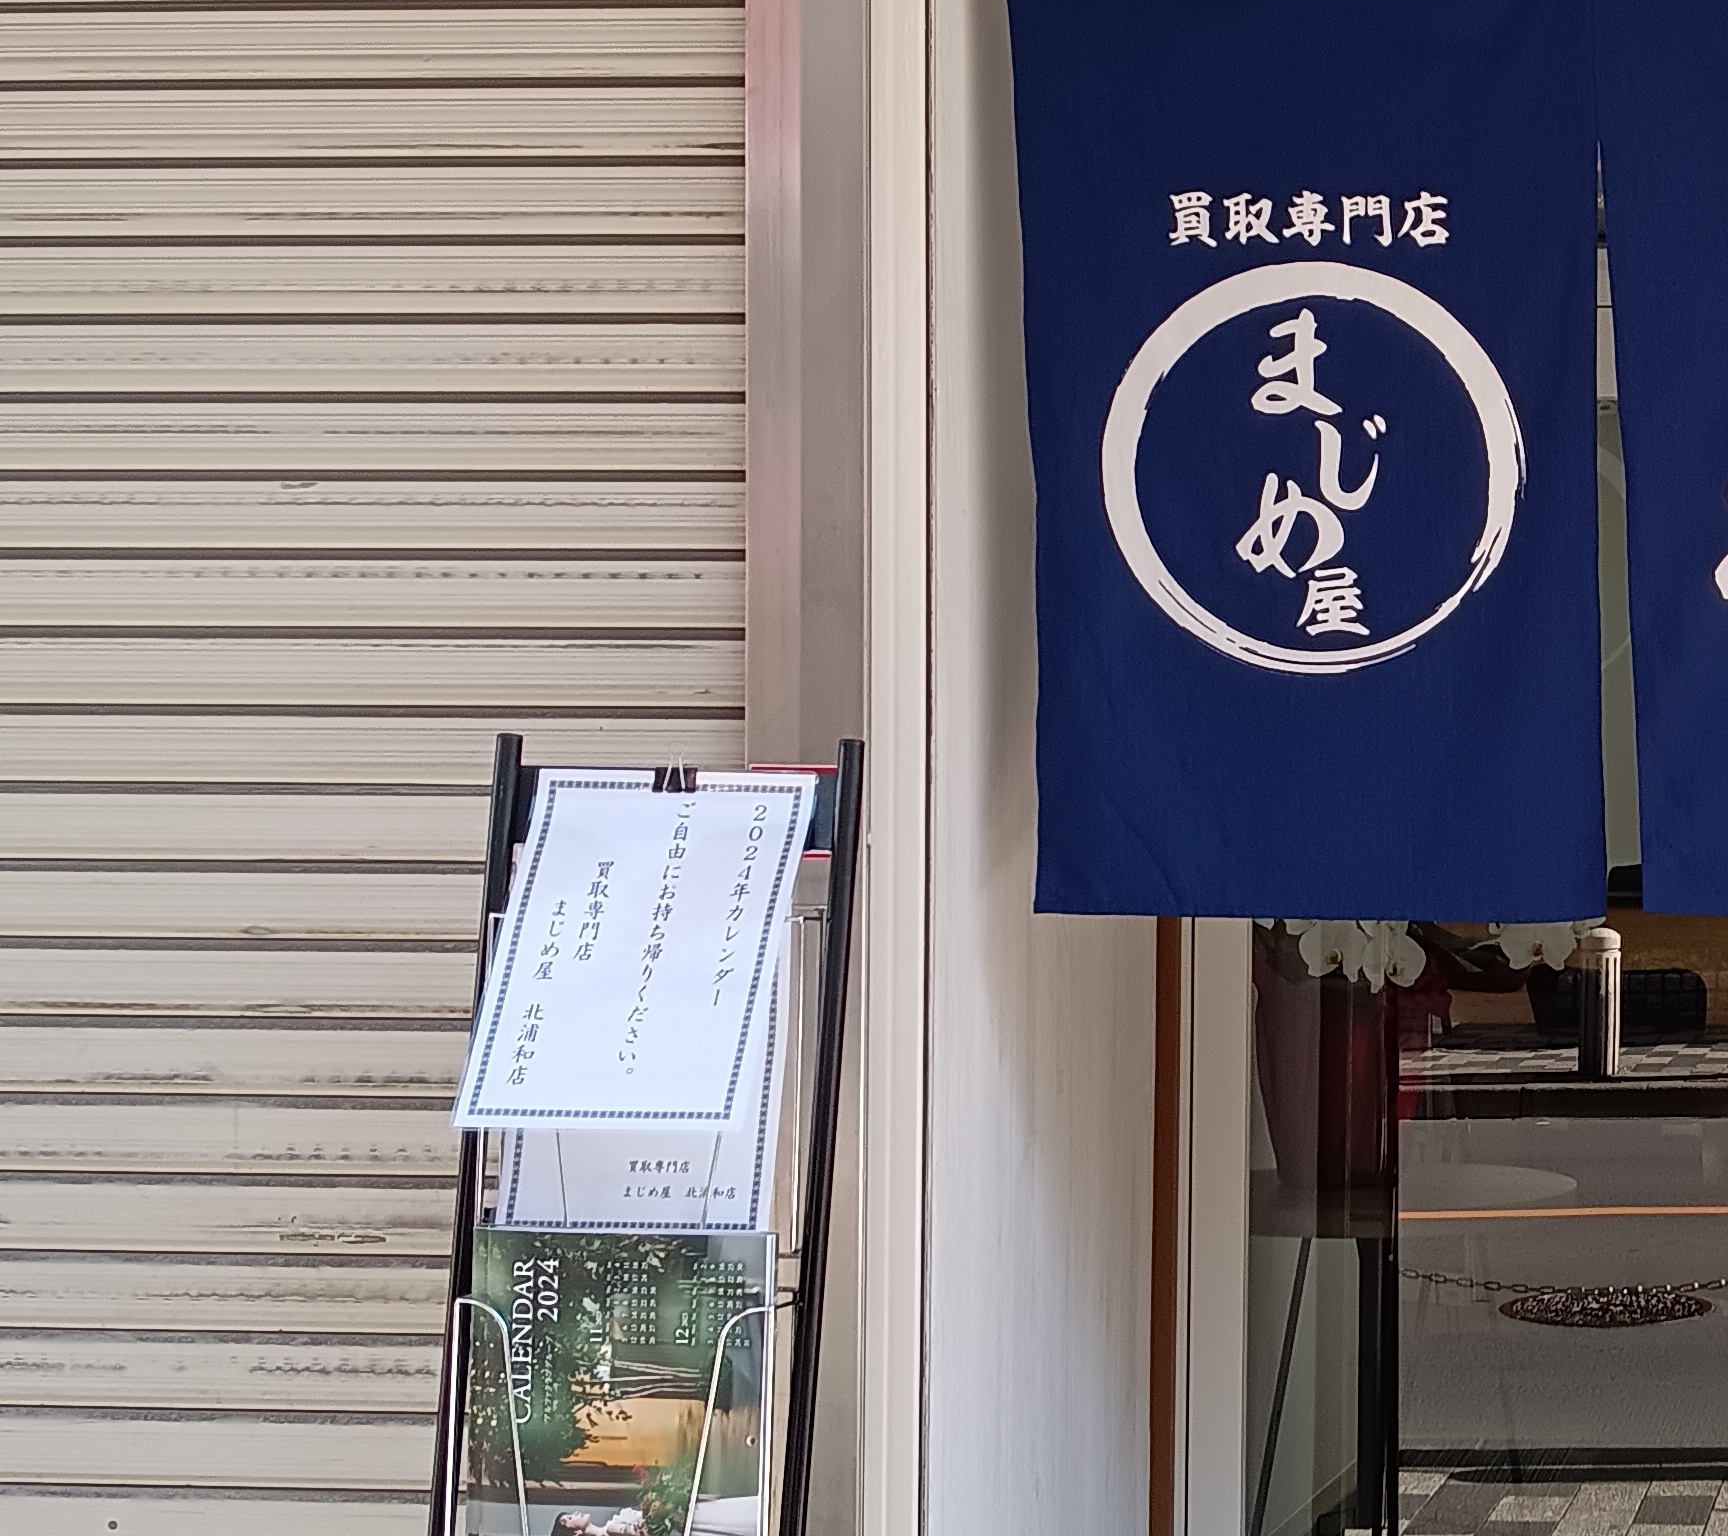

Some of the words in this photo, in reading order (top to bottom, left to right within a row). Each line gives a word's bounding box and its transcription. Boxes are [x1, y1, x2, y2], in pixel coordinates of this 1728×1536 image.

[1168, 190, 1450, 248] 買取専門店
[1236, 308, 1387, 636] まじめ屋
[534, 900, 567, 982] まじめ屋
[573, 860, 615, 961] 買取専門店
[618, 801, 696, 1076] ご自由にお持ち帰りください。
[711, 803, 768, 1007] 2024年カレンダー
[506, 1003, 544, 1086] 北浦和店
[622, 1186, 673, 1200] まじめ屋
[628, 1159, 691, 1174] 買取専門店
[538, 1257, 561, 1322] 2024
[510, 1257, 536, 1424] CALENDAR
[674, 1328, 690, 1345] 12
